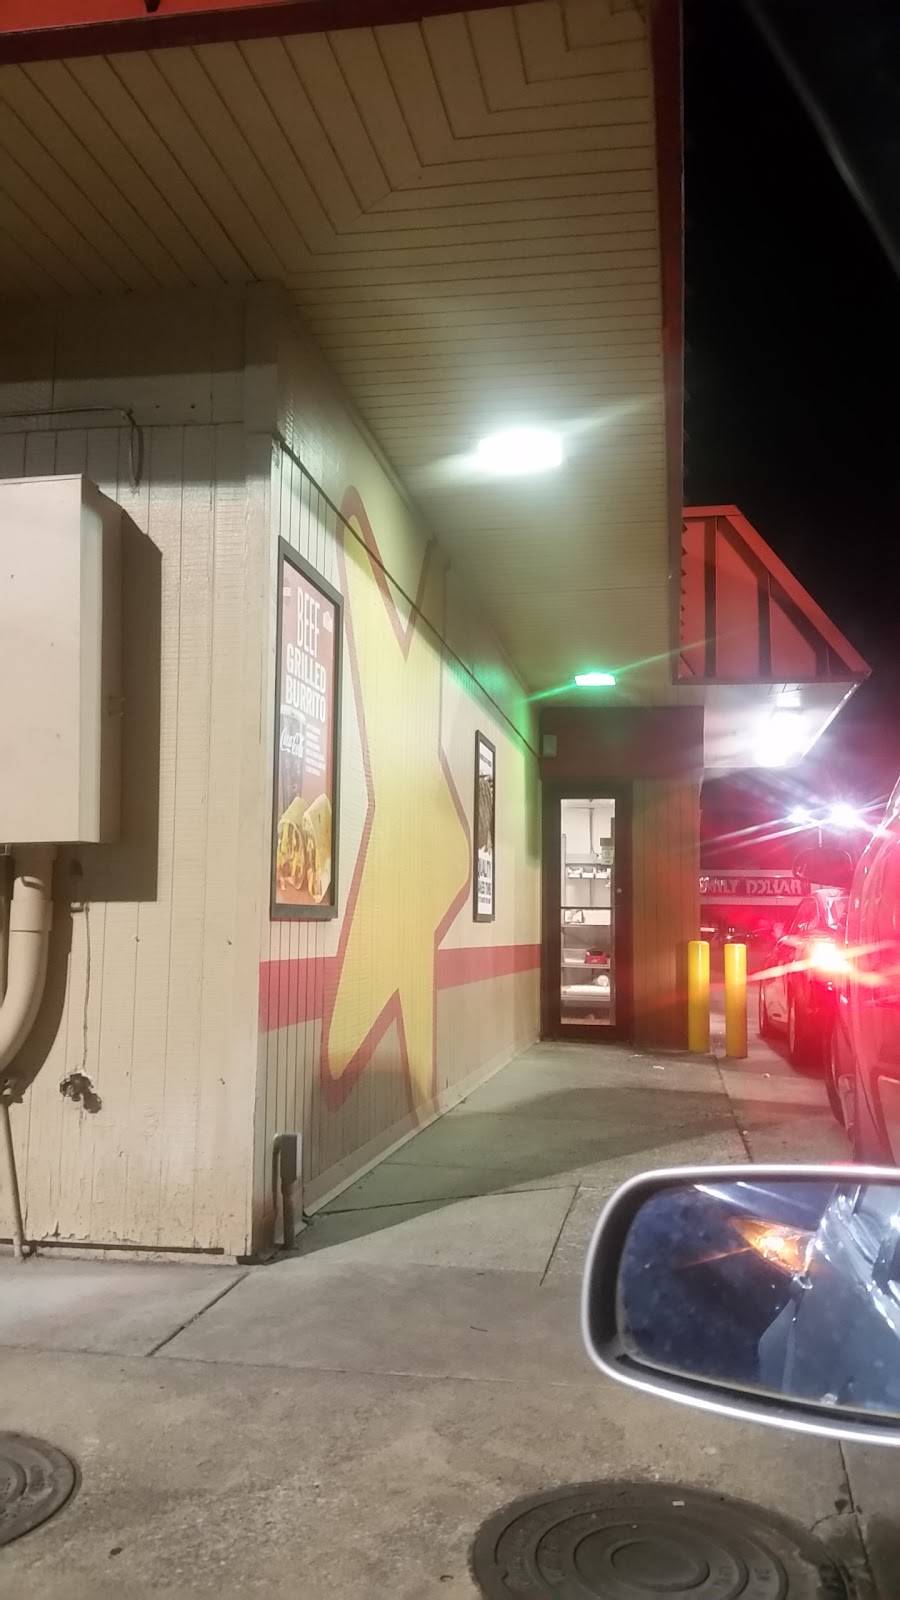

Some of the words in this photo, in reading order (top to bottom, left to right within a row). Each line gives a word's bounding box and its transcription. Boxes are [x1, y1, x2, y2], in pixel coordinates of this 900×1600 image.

[297, 586, 321, 658] BEEF
[287, 642, 326, 694] GRILLED
[286, 673, 326, 723] BURRITO
[745, 879, 803, 895] DOLLAR
